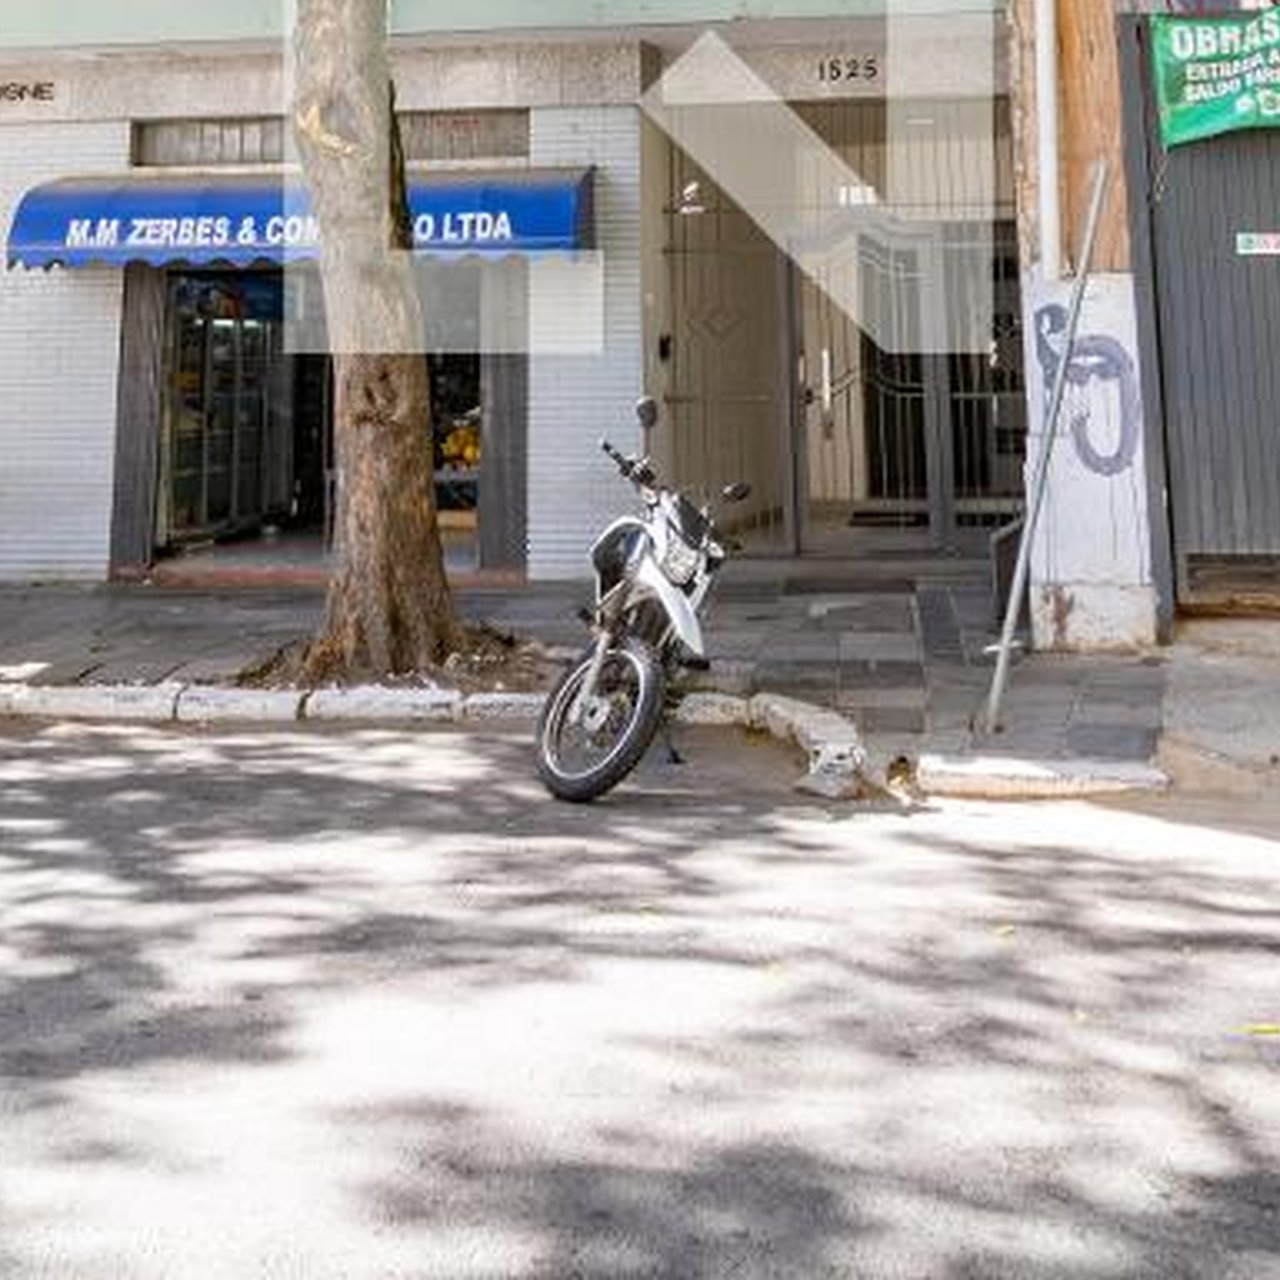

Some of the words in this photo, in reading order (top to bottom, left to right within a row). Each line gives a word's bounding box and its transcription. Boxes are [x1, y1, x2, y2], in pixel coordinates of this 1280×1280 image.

[1172, 10, 1280, 59] OBRAS
[1185, 54, 1265, 81] ENTRADA
[126, 217, 231, 245] ZERBES
[237, 216, 257, 244] &
[443, 212, 512, 241] LTDA
